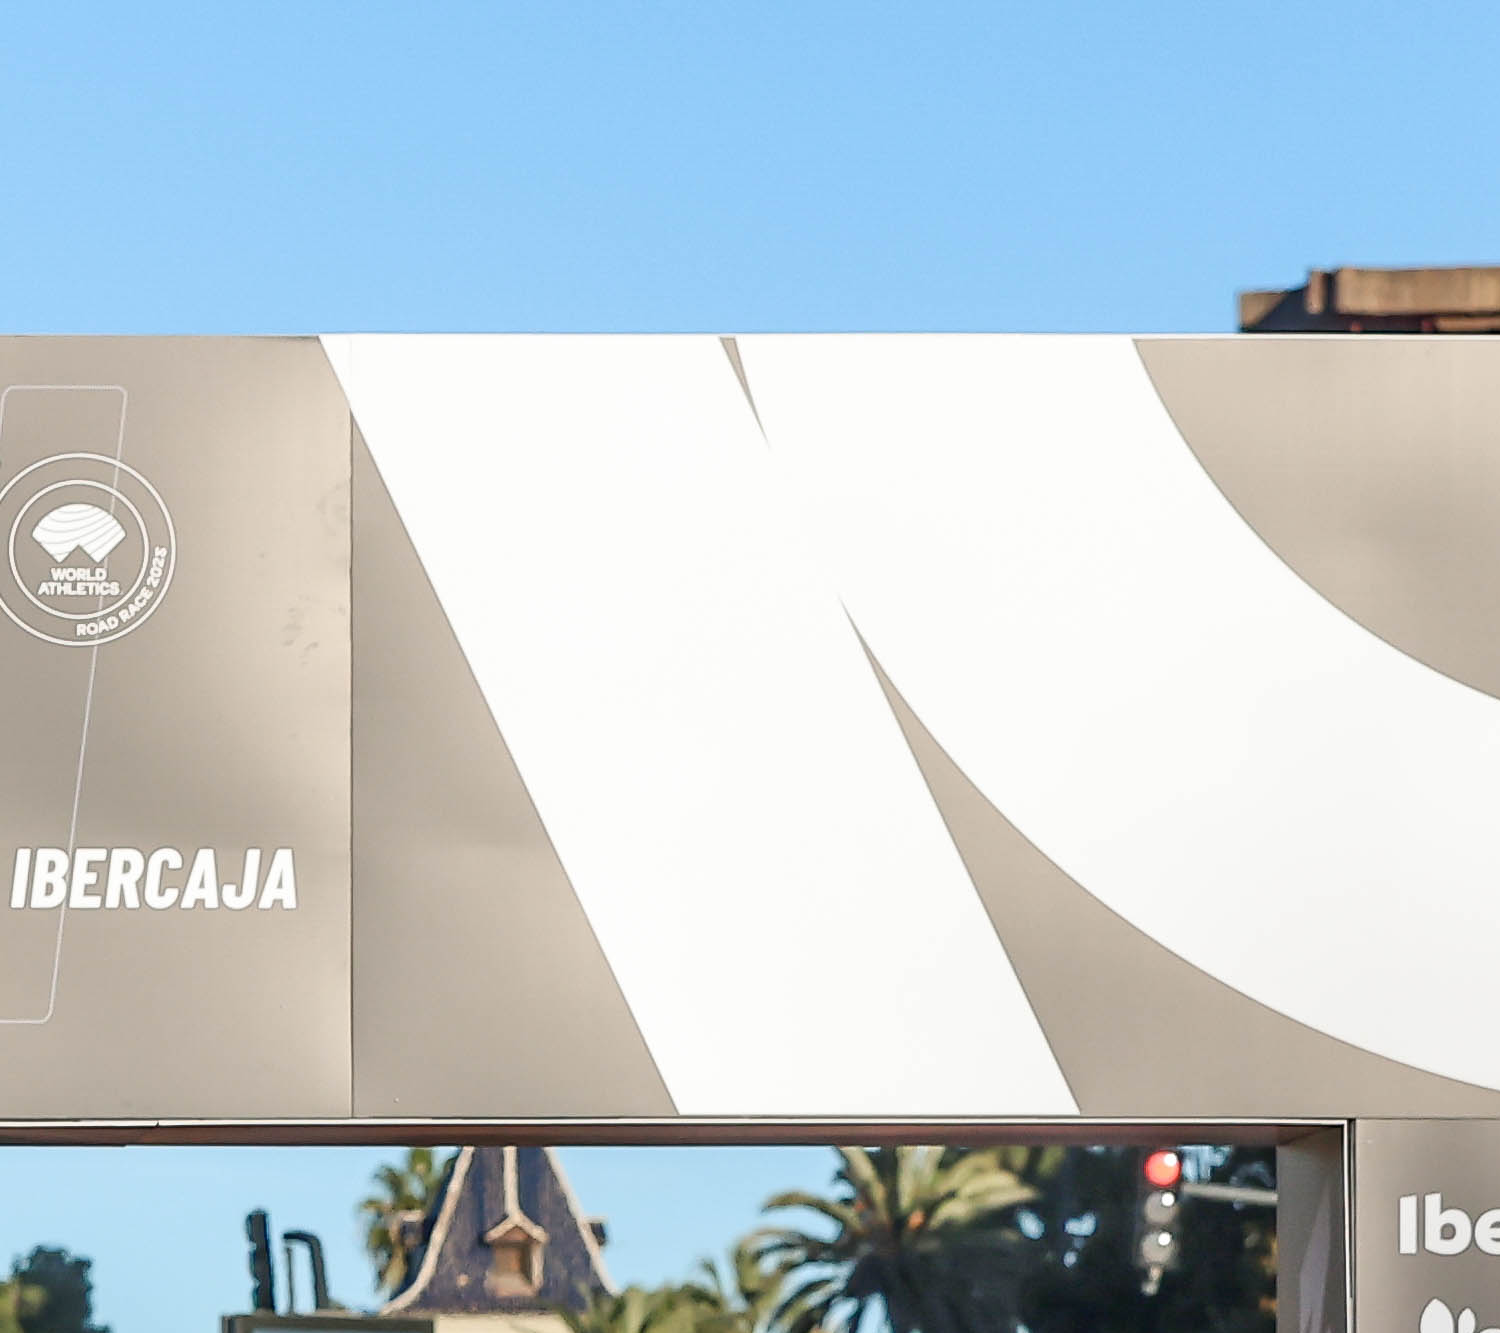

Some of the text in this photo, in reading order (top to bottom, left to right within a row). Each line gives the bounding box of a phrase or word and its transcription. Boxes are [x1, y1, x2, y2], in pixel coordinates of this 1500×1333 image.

[37, 582, 120, 595] ATHLETICS
[50, 567, 107, 581] WORLD
[76, 618, 119, 636] ROAD
[118, 587, 153, 622] RACE
[8, 847, 298, 910] IBERCAJA
